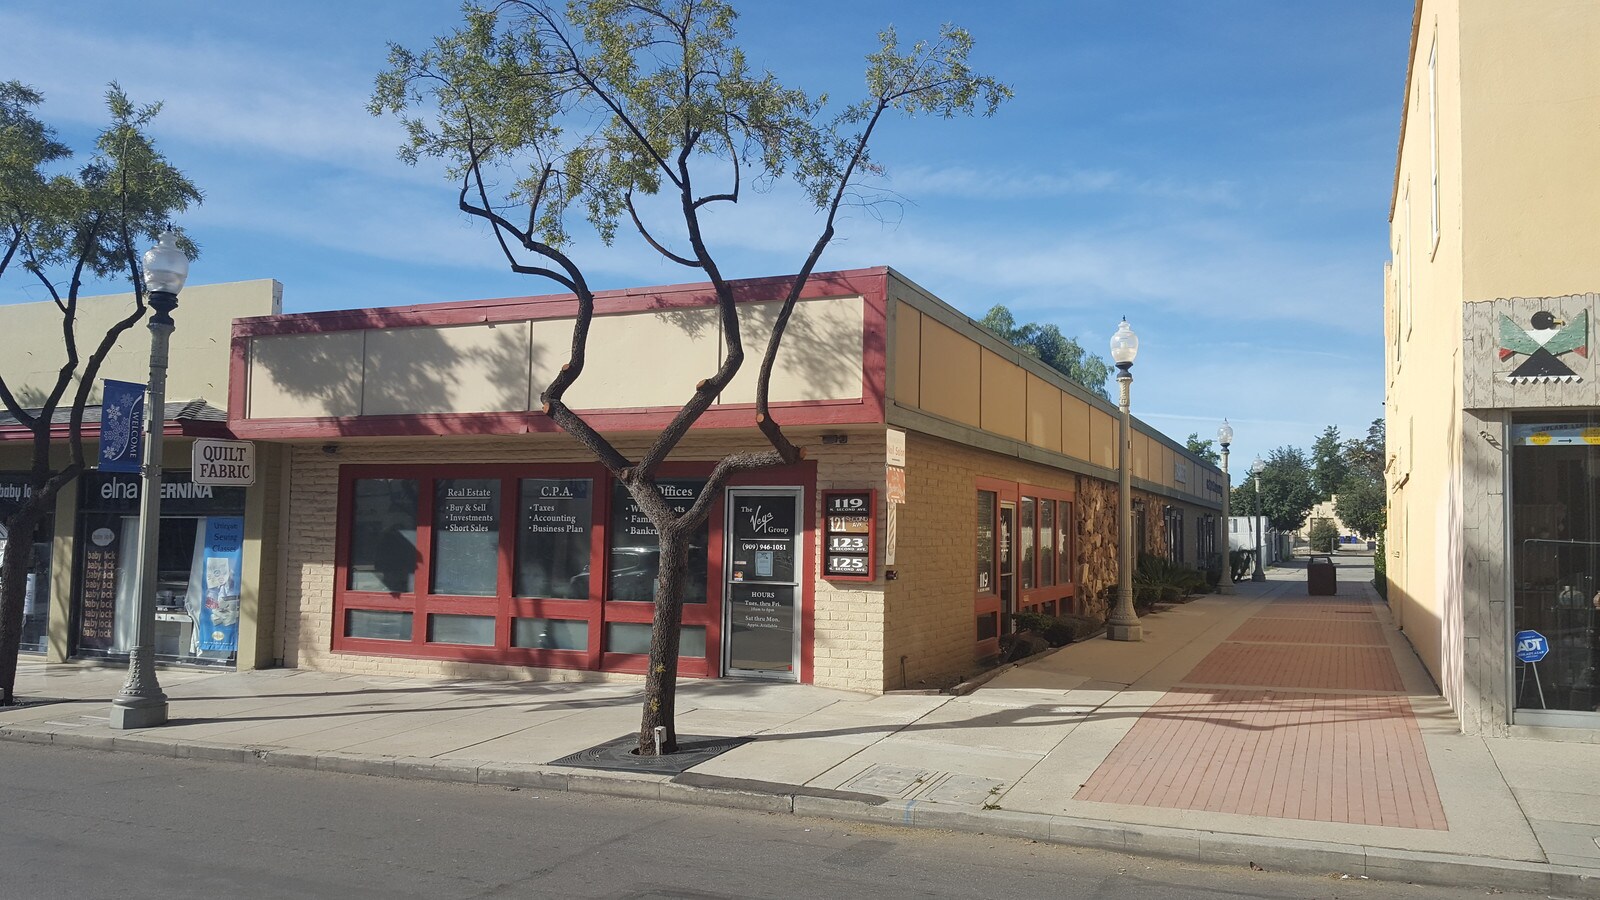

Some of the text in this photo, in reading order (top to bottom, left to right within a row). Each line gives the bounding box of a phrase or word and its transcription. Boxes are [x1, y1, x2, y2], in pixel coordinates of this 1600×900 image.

[129, 411, 140, 458] WELCOME
[203, 445, 246, 462] QUILT
[200, 463, 250, 479] FABRIC
[0, 483, 32, 501] baby lo
[101, 477, 138, 499] elna
[160, 482, 213, 499] ERNINA
[448, 488, 491, 497] Real Estate
[541, 486, 573, 497] C.P.A.
[533, 503, 555, 512] Taxes
[835, 498, 863, 508] 119
[450, 503, 486, 514] Buy & Sell
[450, 513, 493, 522] Investments
[533, 514, 576, 524] Accounting
[750, 505, 774, 533] Vega
[450, 524, 489, 532] Short Sales
[532, 524, 584, 533] Business Plan
[830, 516, 846, 532] 121
[768, 526, 789, 534] Group
[742, 543, 758, 551] (909)
[833, 538, 864, 548] 123
[833, 558, 863, 568] 125
[1517, 638, 1542, 652] ADT
